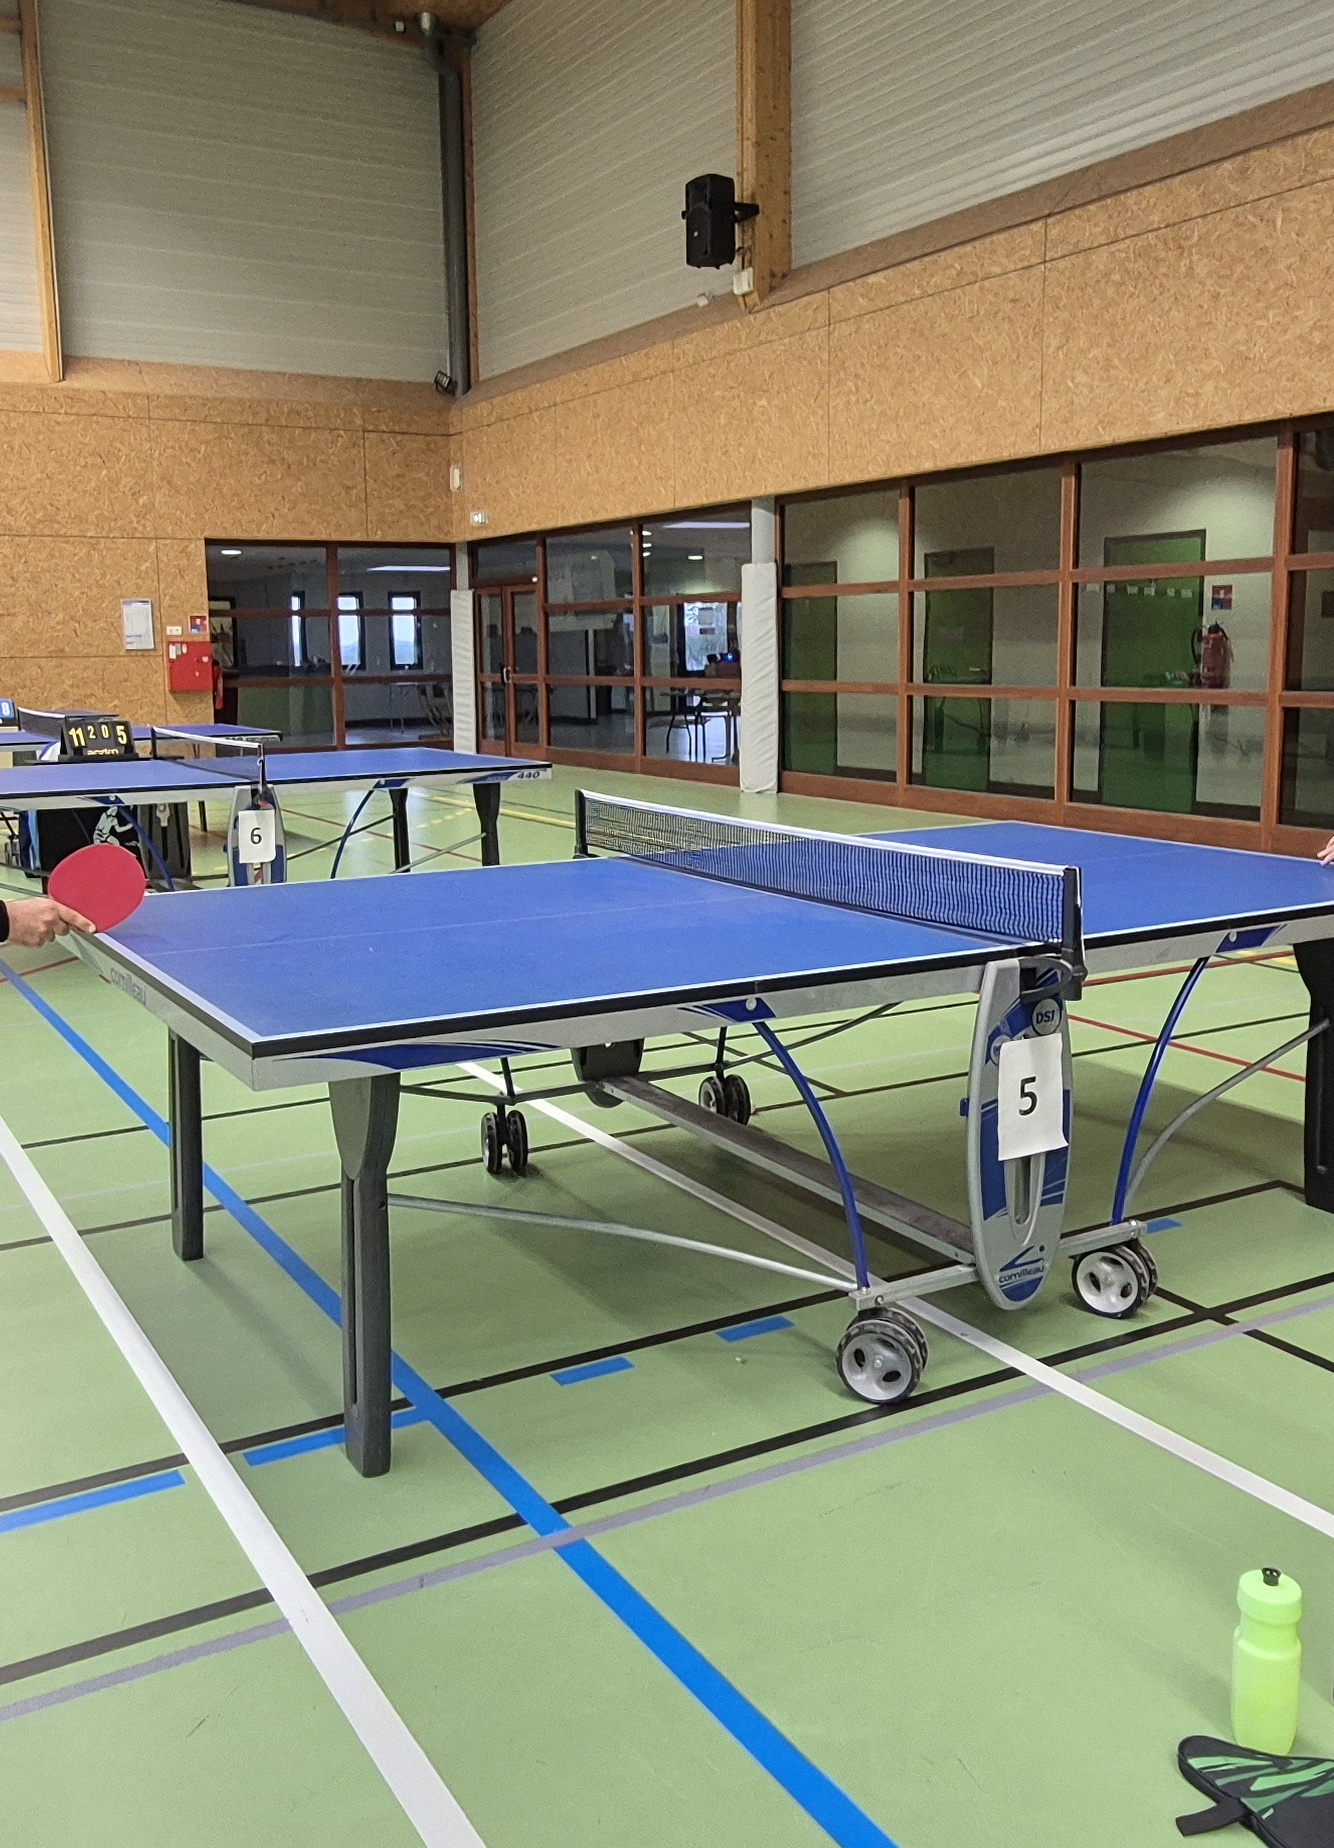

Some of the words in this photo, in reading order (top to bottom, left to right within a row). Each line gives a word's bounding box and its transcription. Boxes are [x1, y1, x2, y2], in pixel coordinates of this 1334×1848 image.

[68, 727, 86, 747] 11
[87, 725, 97, 739] 2
[101, 724, 109, 738] 0
[116, 725, 127, 744] 5
[517, 771, 541, 779] 440
[250, 827, 262, 845] 6
[1018, 1075, 1038, 1117] 5
